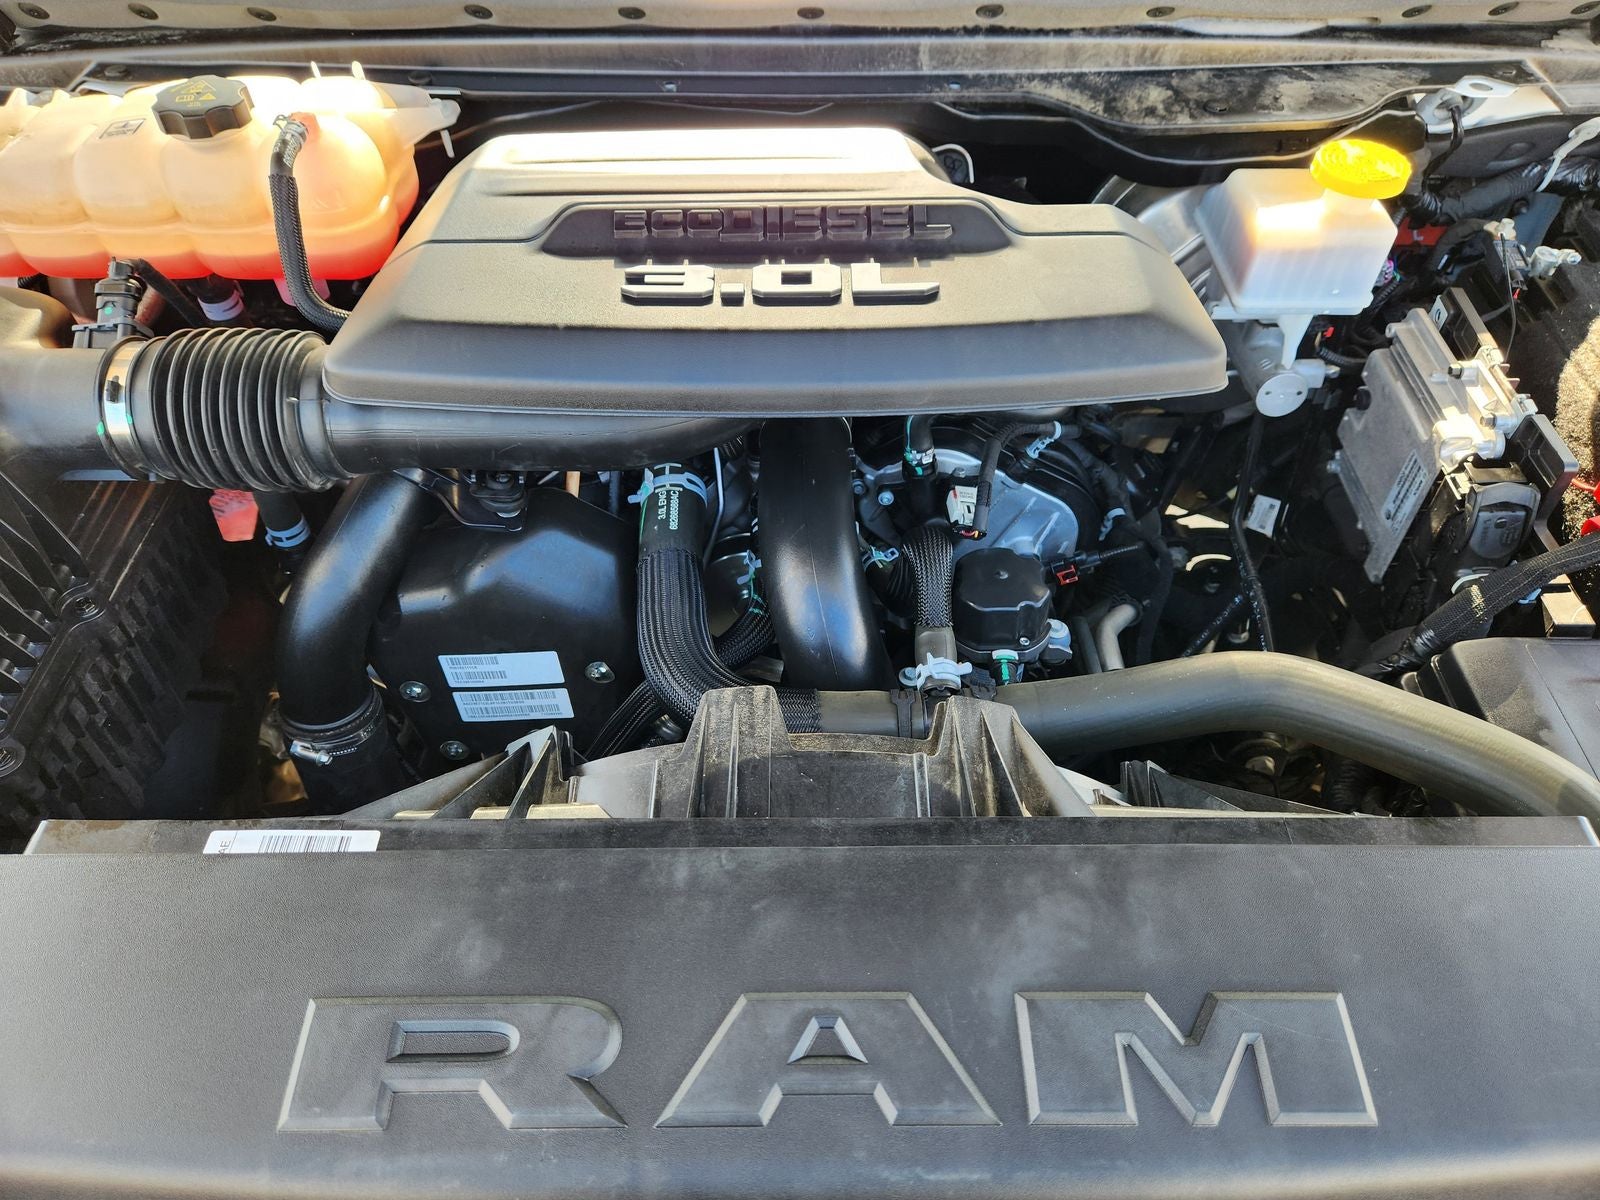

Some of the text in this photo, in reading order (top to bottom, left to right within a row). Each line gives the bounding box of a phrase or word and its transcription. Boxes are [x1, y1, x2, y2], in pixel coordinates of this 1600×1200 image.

[613, 204, 953, 242] ECODIESEL
[621, 262, 940, 306] 3.0L
[657, 490, 667, 520] 3.0L ENG
[275, 990, 1378, 1132] RAM
